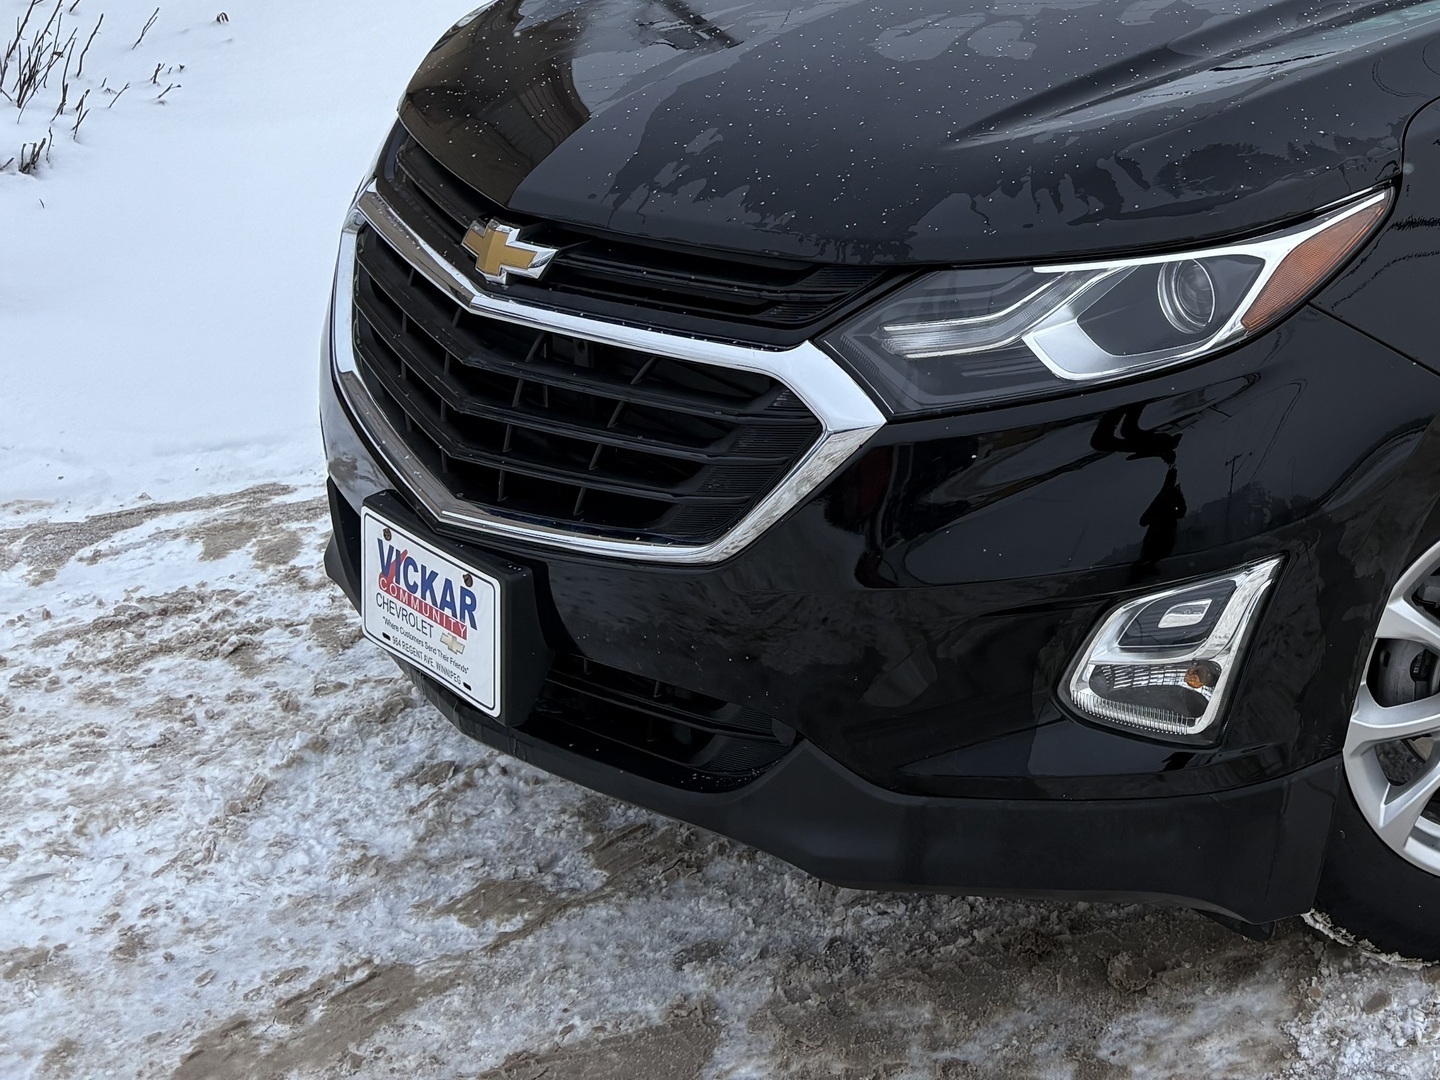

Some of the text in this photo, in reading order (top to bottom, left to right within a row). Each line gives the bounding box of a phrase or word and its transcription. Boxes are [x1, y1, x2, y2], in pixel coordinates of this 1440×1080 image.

[377, 537, 478, 631] VICKAR
[379, 576, 468, 639] COMMUNITY
[376, 592, 435, 639] CHEVROLET
[399, 625, 424, 647] Customers
[402, 639, 423, 661] REGENT
